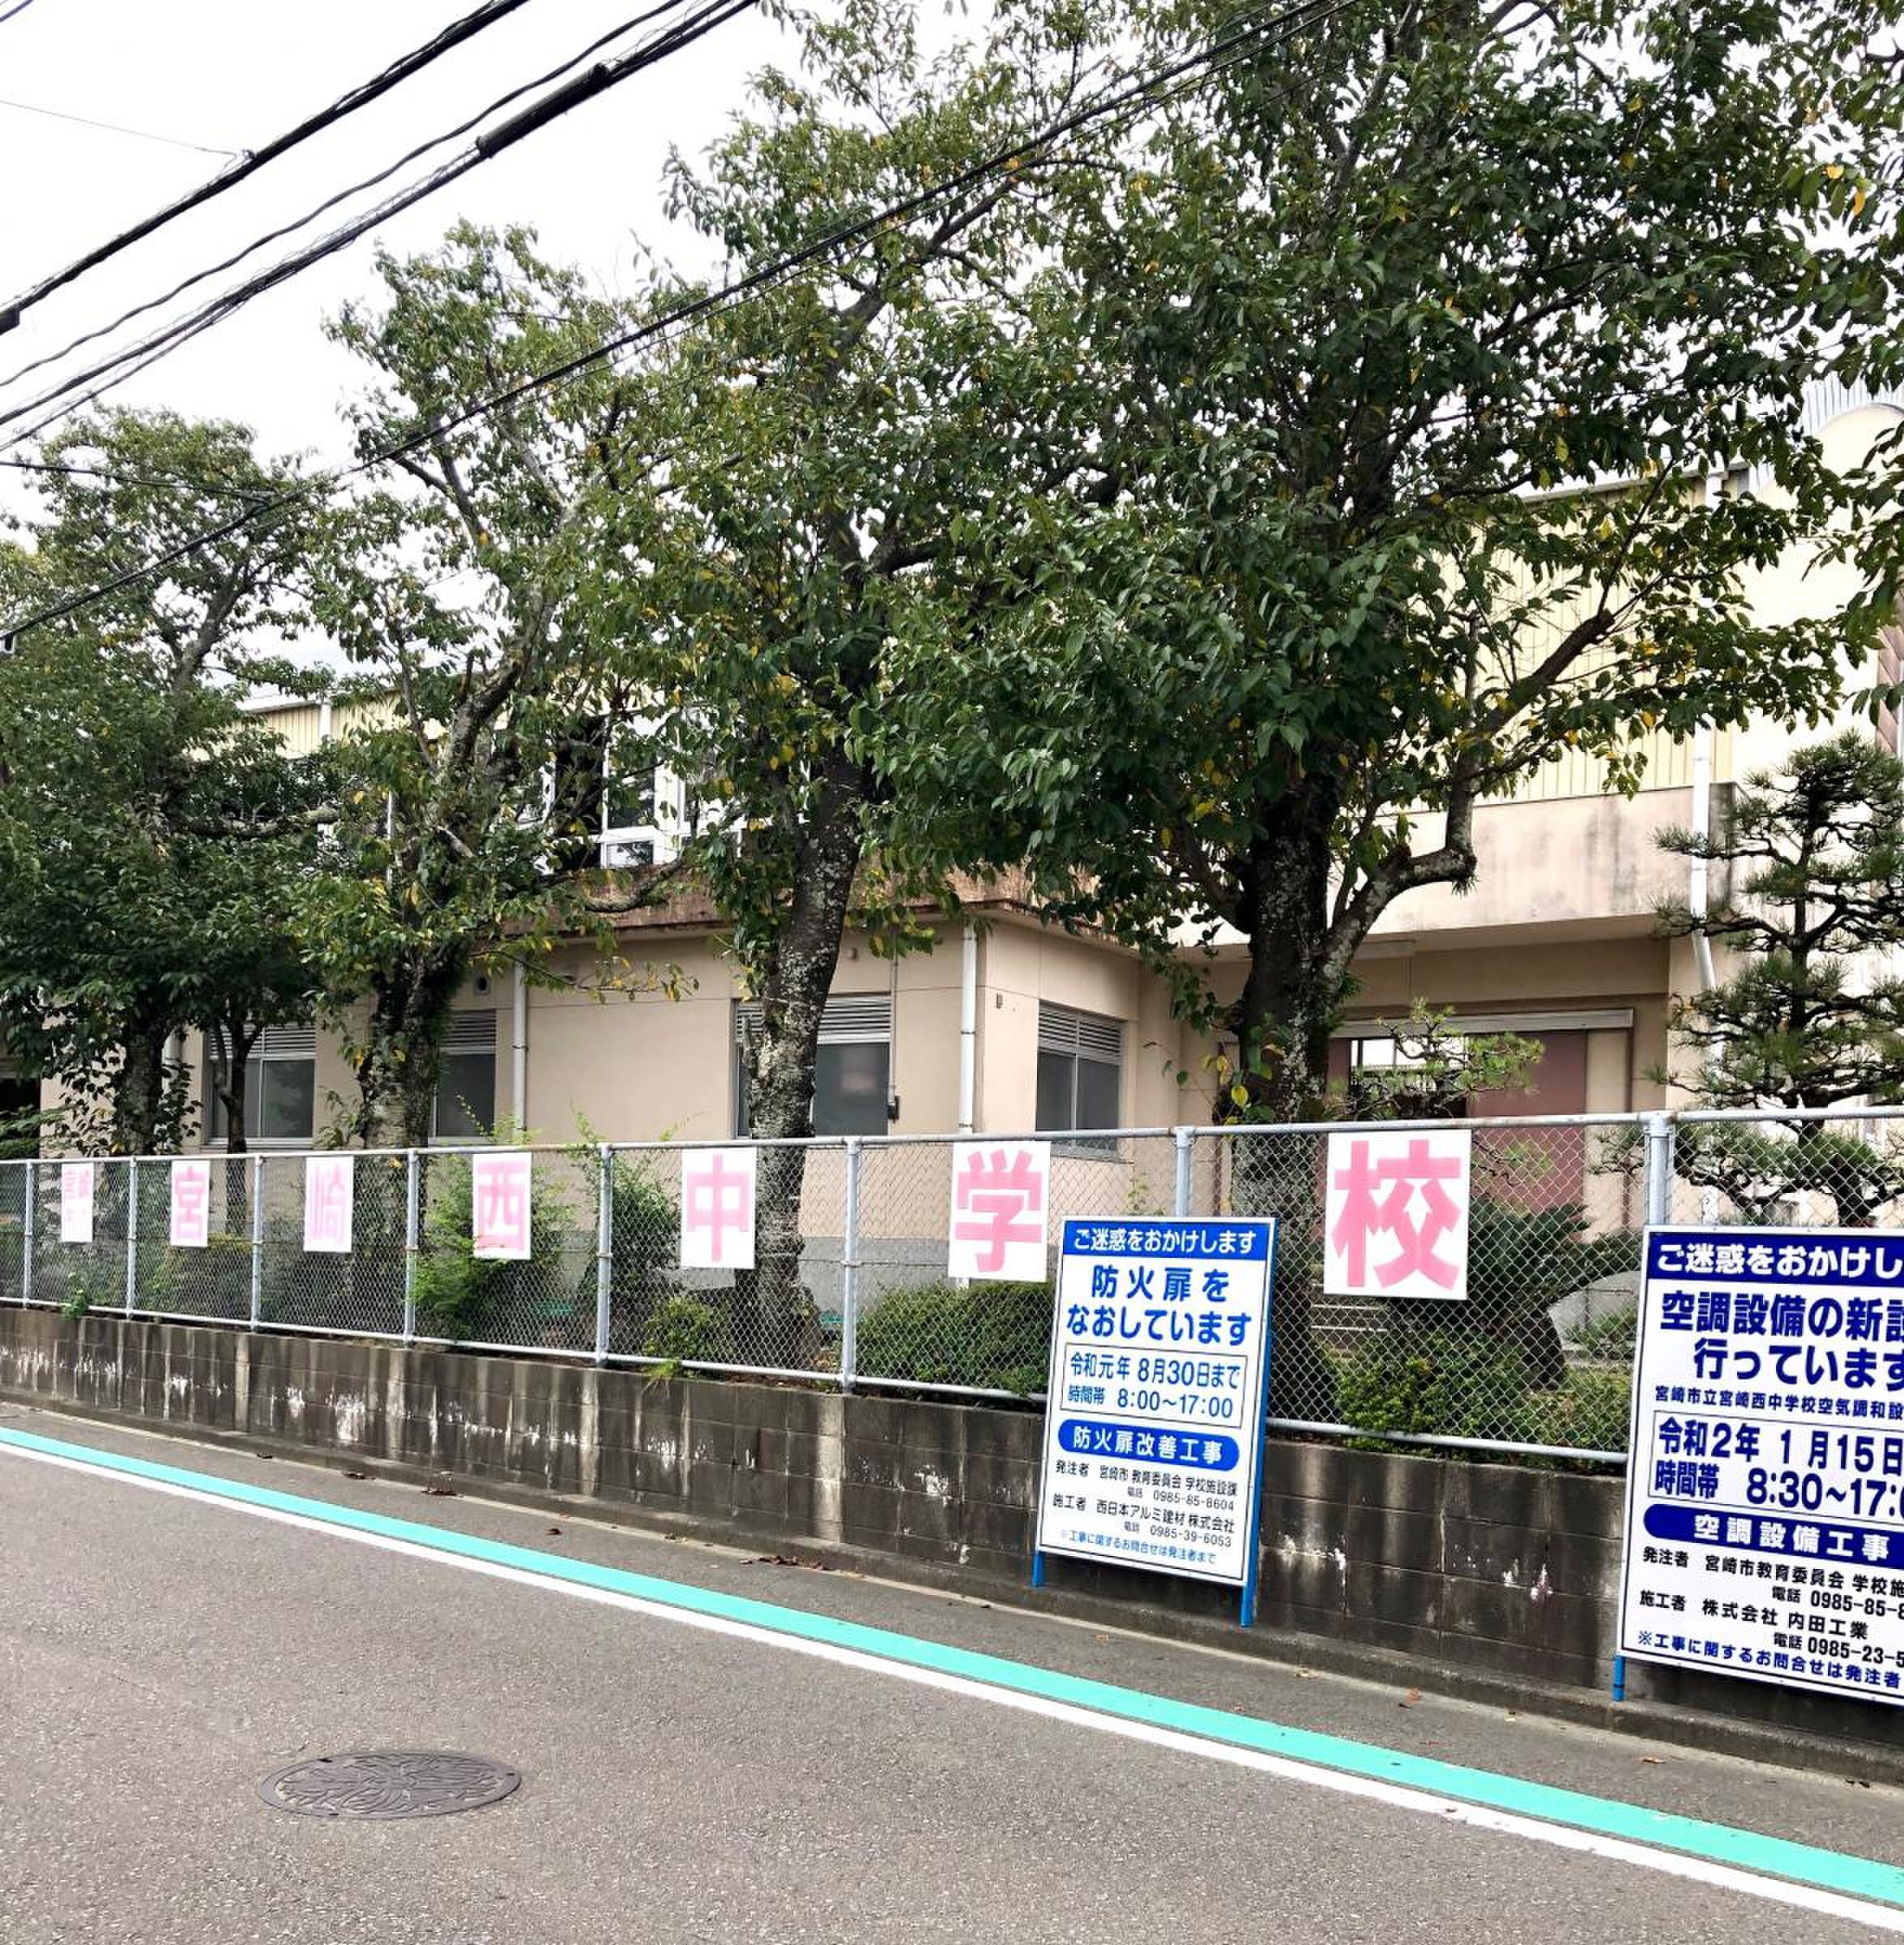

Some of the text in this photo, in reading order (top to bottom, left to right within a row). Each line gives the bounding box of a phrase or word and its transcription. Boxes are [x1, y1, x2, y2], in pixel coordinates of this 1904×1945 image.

[174, 1165, 206, 1241] 宮
[478, 1161, 526, 1251] 西
[686, 1152, 750, 1263] 中
[954, 1148, 1043, 1272] 学
[1331, 1139, 1462, 1290] 校
[1074, 1228, 1257, 1254] ご迷惑をおかけします
[1658, 1242, 1903, 1280] ご迷惑をおかけし
[1091, 1264, 1229, 1302] 防火扉を
[1066, 1304, 1252, 1346] なおしています
[1693, 1337, 1904, 1391] 行っています
[1067, 1384, 1105, 1405] 時間帯
[1073, 1425, 1223, 1464] 防火扉改善工事
[1056, 1459, 1089, 1477] 発注者
[1052, 1493, 1086, 1511] 施工者
[1153, 1490, 1234, 1511] 0985-85-8604
[1654, 1460, 1904, 1520] 時間帯 8:30～17:
[1643, 1545, 1689, 1568] 発注者
[1693, 1514, 1890, 1562] 空調設備工事
[1772, 1585, 1801, 1604] 電話
[1639, 1589, 1868, 1640] 施工者 株式会社 内田工業
[1774, 1631, 1904, 1669] 電話 0985-23-5
